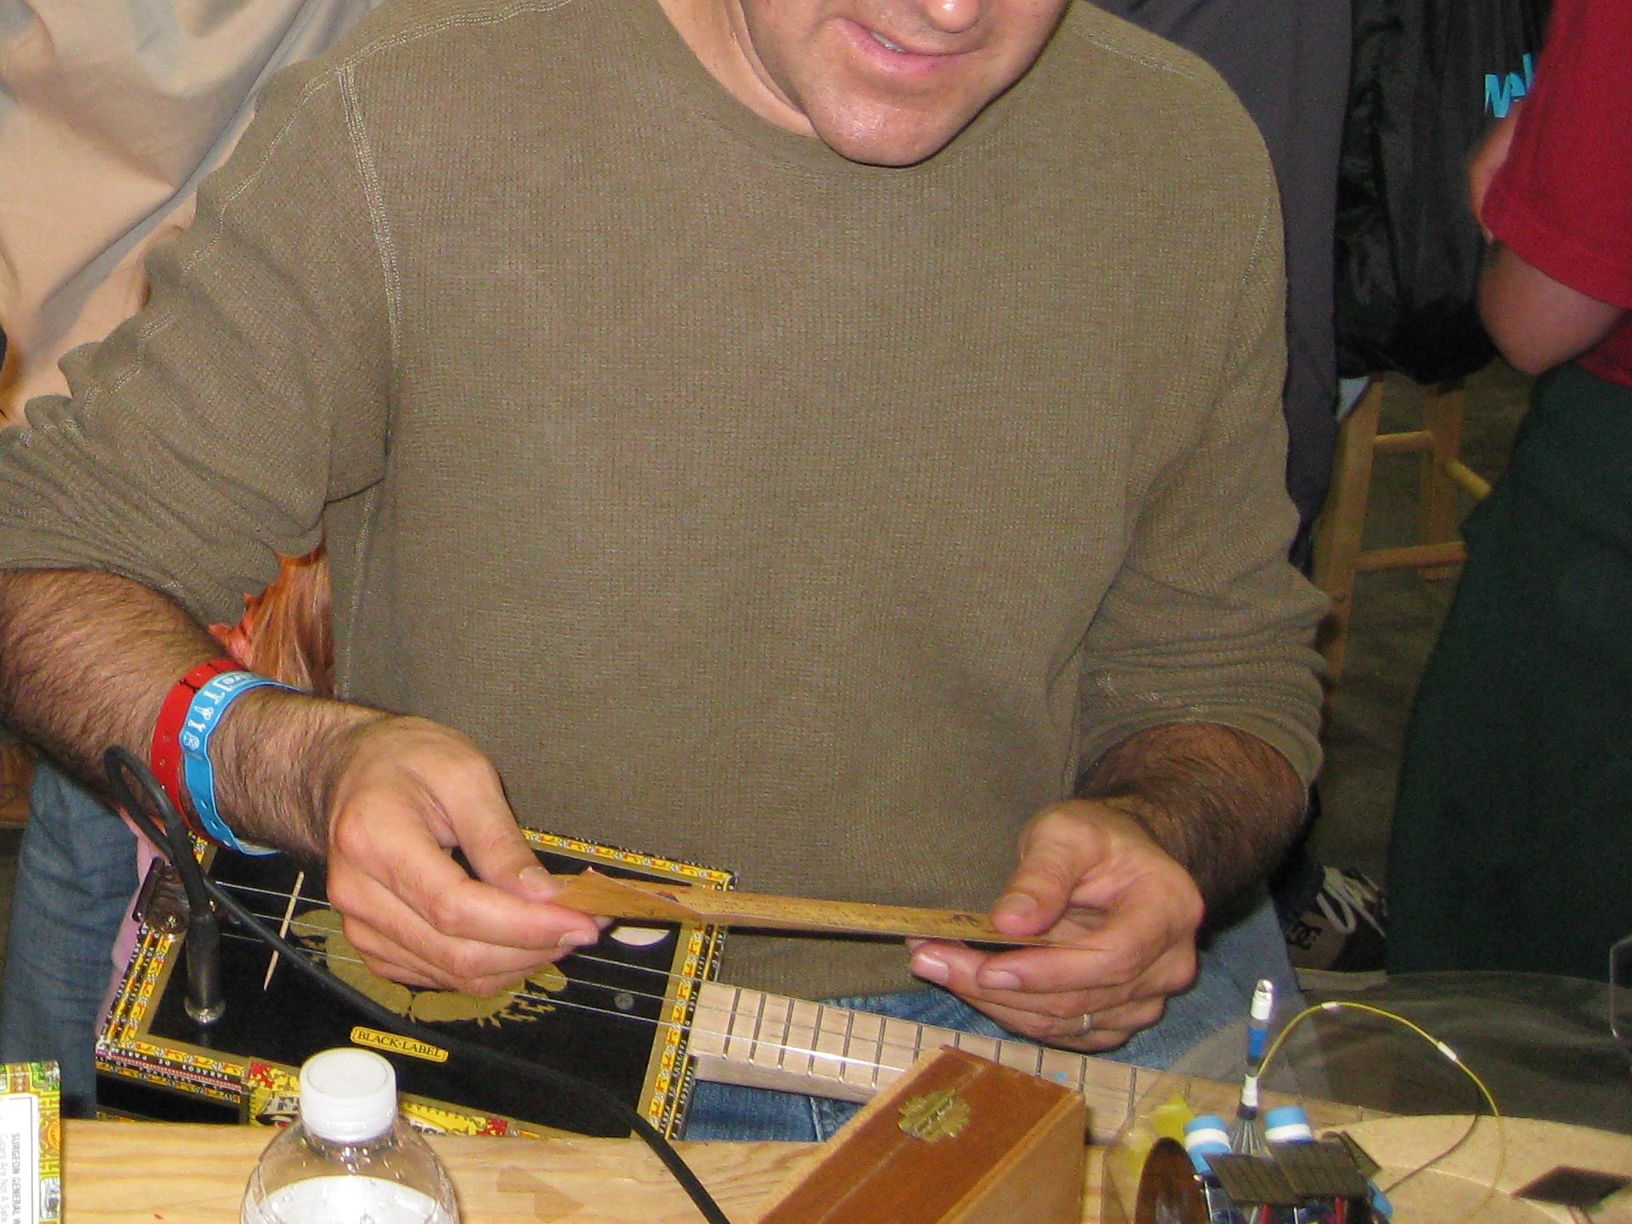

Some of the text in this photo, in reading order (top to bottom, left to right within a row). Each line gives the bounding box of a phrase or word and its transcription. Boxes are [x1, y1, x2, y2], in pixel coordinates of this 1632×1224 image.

[11, 1132, 22, 1174] SURGEON
[0, 1161, 10, 1176] Are
[0, 1178, 10, 1193] Not
[11, 1176, 22, 1216] GENERAL
